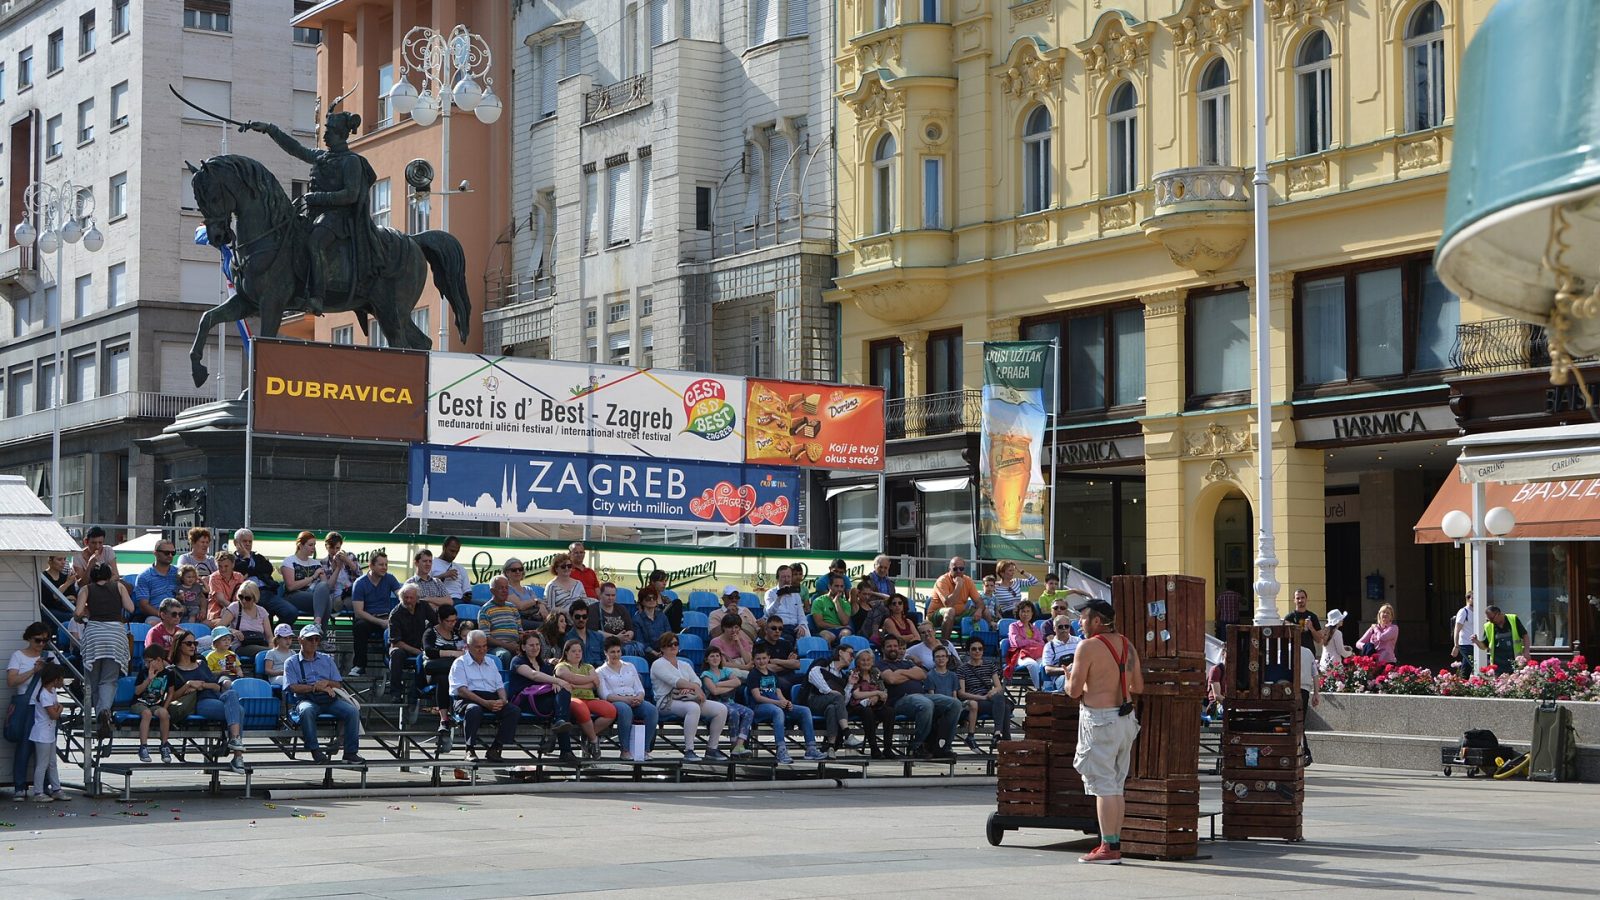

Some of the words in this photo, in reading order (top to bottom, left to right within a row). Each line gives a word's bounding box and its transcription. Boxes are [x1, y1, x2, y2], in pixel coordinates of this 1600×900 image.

[1002, 366, 1030, 379] PRAGA
[266, 376, 413, 405] DUBRAVICA
[685, 381, 721, 407] CEST
[438, 391, 482, 417] Cest
[490, 395, 507, 419] is
[541, 399, 585, 424] Best
[606, 403, 673, 432] Zagreb
[828, 396, 858, 418] Dorina
[694, 407, 731, 432] BEST
[1332, 410, 1427, 438] HARMICA
[522, 424, 553, 434] festival
[561, 426, 614, 438] international
[616, 429, 640, 440] street
[642, 431, 671, 442] festival
[829, 442, 847, 453] Koji
[848, 443, 858, 454] je
[860, 444, 880, 455] tvoj
[825, 453, 847, 464] okus
[849, 454, 879, 465] sreće?
[1551, 454, 1581, 472] CARLING
[1478, 460, 1505, 477] CARLING
[528, 460, 687, 499] ZAGREB
[592, 498, 615, 514] City
[618, 500, 642, 513] with
[646, 502, 683, 515] million
[717, 496, 752, 511] ZAGREB
